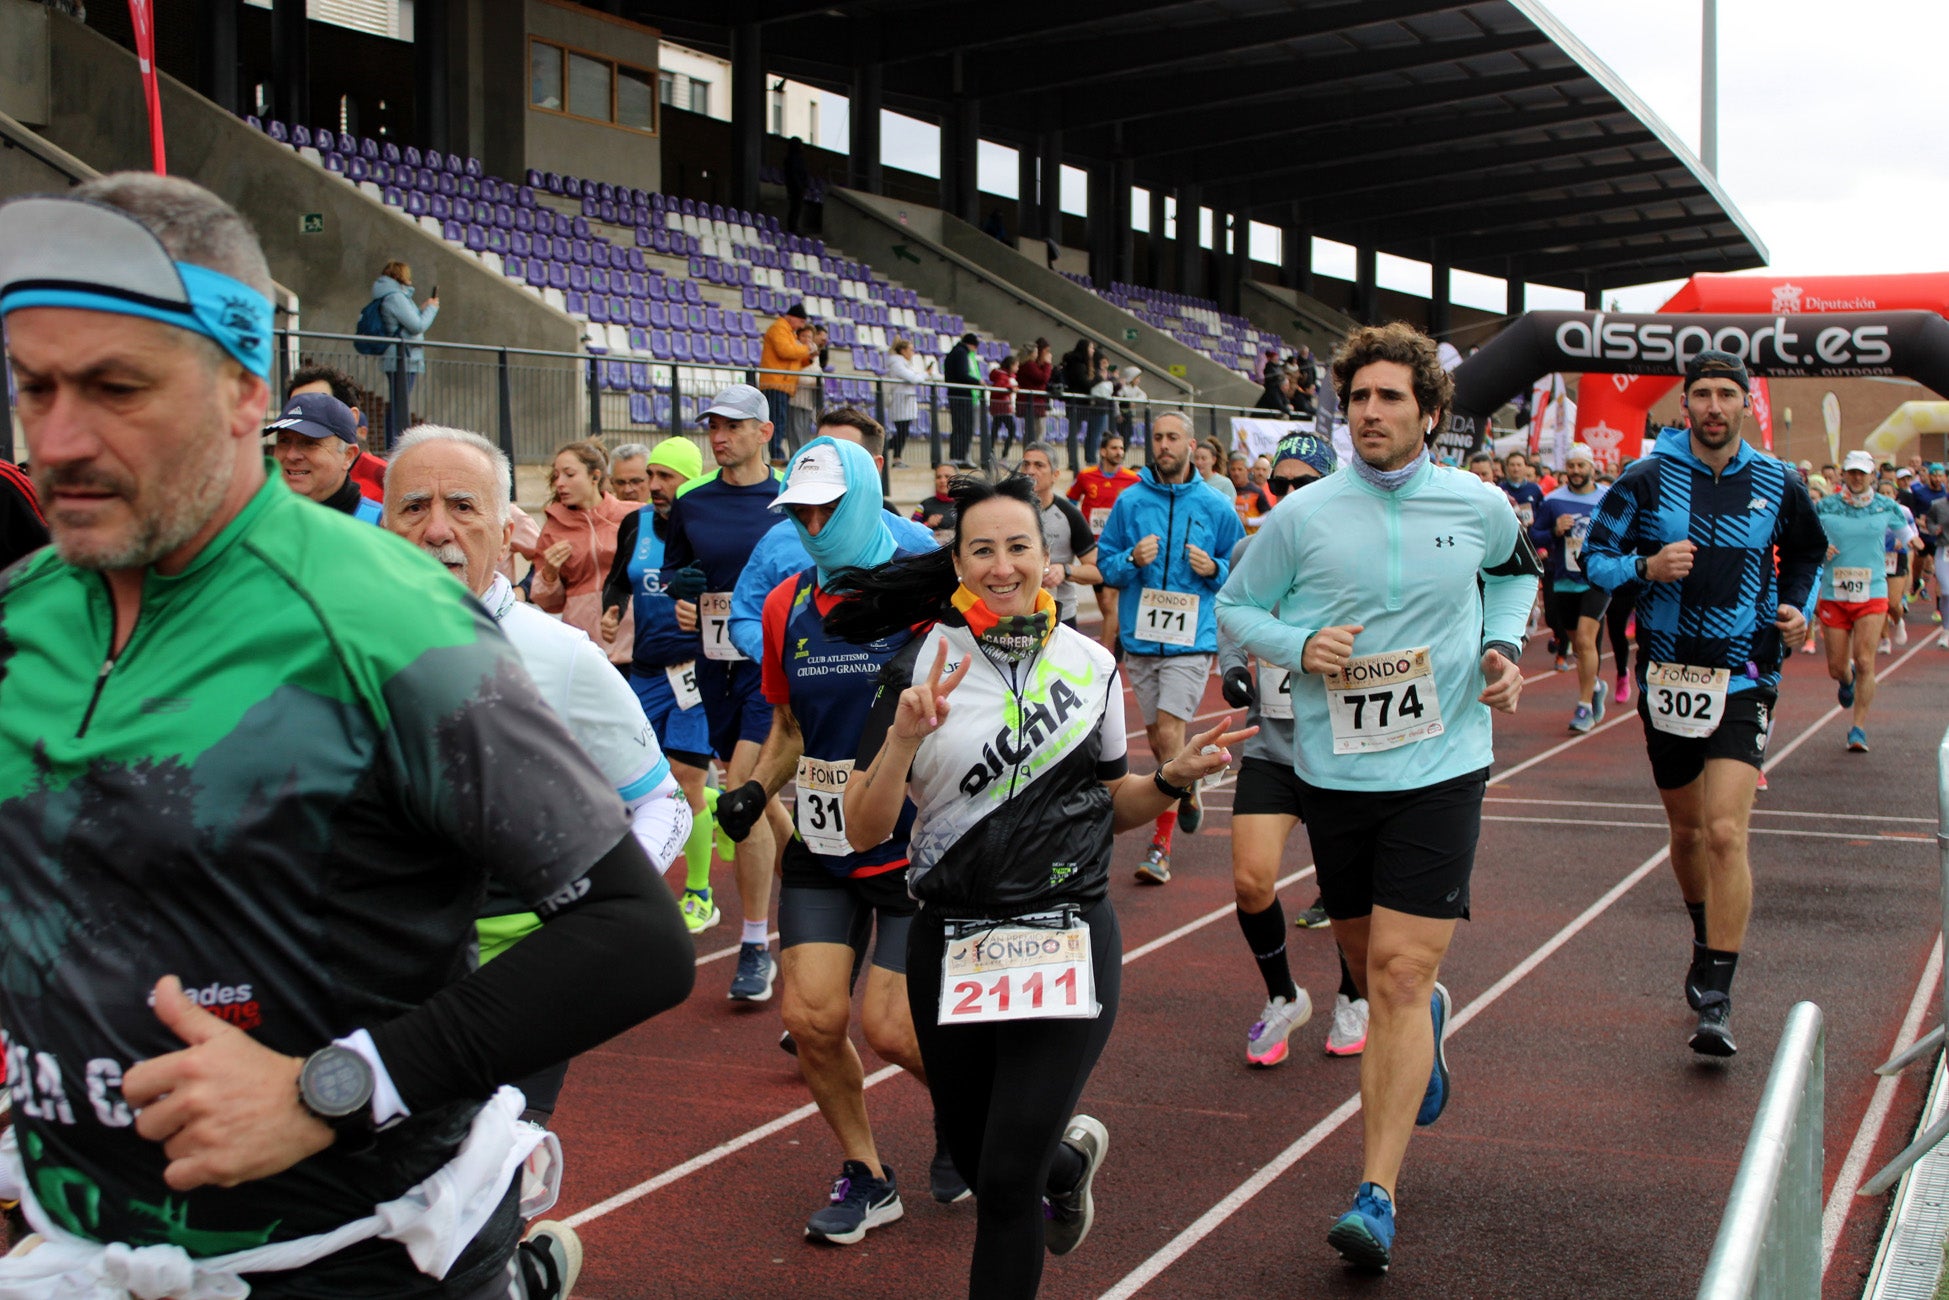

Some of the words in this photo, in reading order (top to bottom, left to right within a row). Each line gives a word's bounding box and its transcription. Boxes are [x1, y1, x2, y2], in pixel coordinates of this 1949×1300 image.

[1805, 296, 1876, 312] Diputación
[1556, 313, 1892, 375] alssport.es
[1147, 609, 1186, 632] 171
[986, 634, 1035, 648] CARRERA
[797, 666, 829, 677] CIUDAD
[836, 663, 881, 674] GRANADA
[807, 656, 826, 664] CLUB
[827, 653, 869, 663] ATLETISMO
[1344, 659, 1411, 682] FONDO
[1663, 669, 1712, 684] FONDO
[1343, 684, 1424, 729] 774
[1657, 689, 1712, 720] 302
[976, 938, 1060, 961] FONDO
[951, 966, 1077, 1016] 2111
